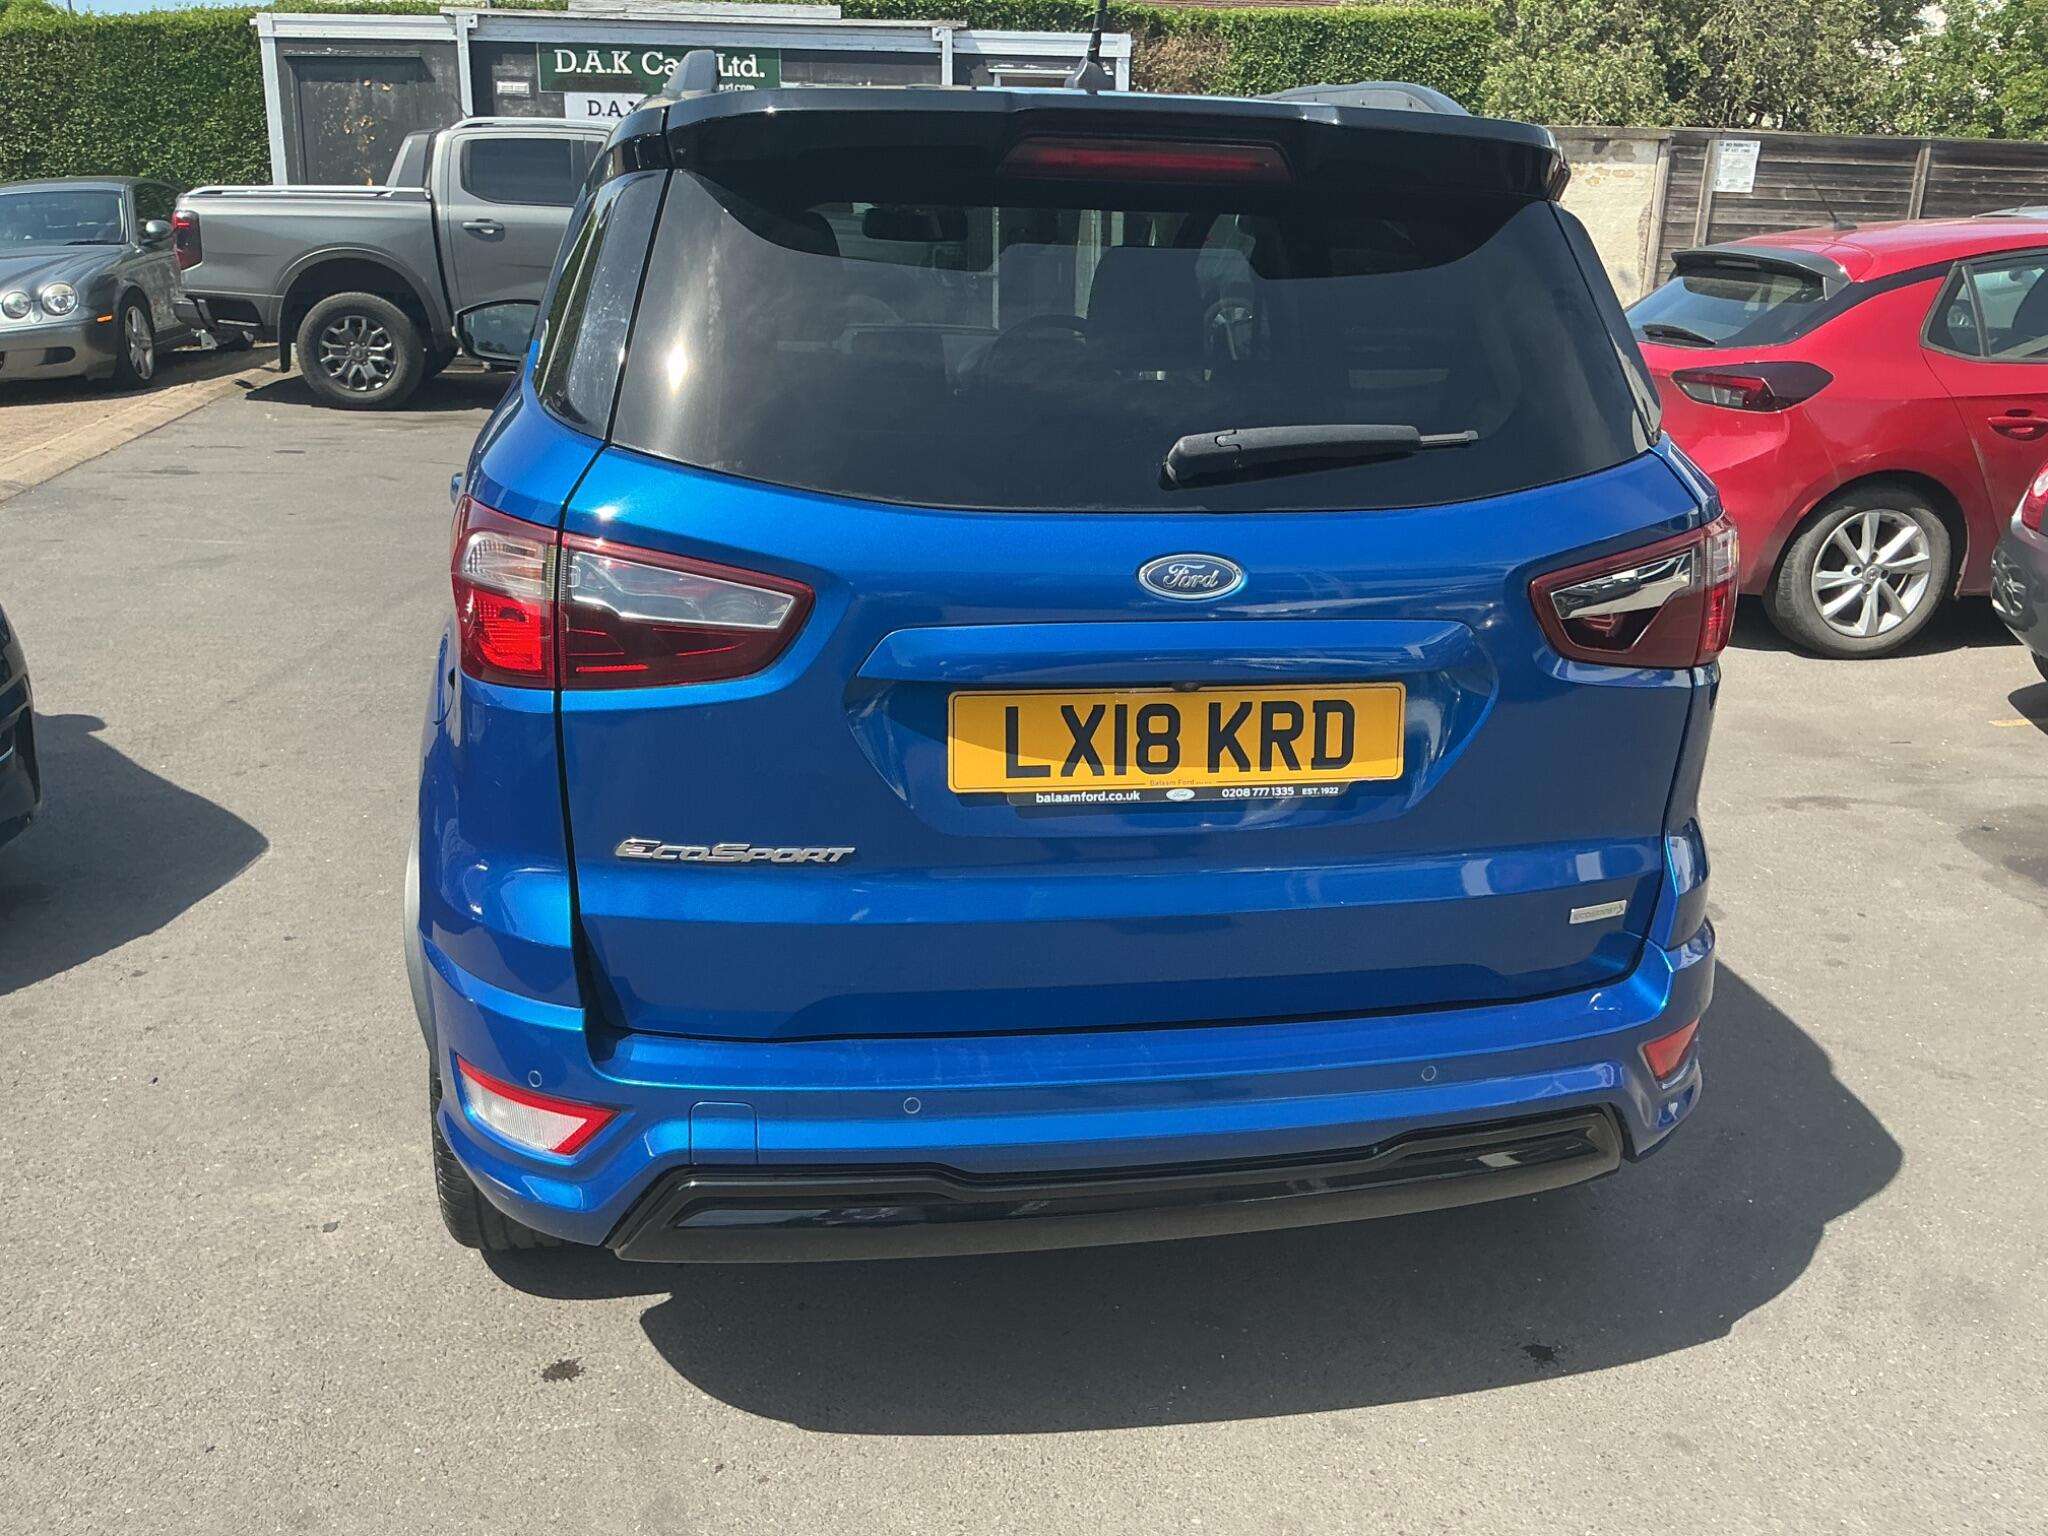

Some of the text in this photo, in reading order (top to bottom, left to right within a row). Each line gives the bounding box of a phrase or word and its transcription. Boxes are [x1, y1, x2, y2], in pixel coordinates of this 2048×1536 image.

[554, 49, 766, 78] D.A.K Ca Ltd.
[1163, 563, 1219, 589] Ford
[1005, 699, 1355, 779] LX18 KRD
[1035, 790, 1141, 804] balaamford.co.uk
[1221, 786, 1295, 798] 0208 777 1335
[1301, 786, 1339, 796] EST. 1922
